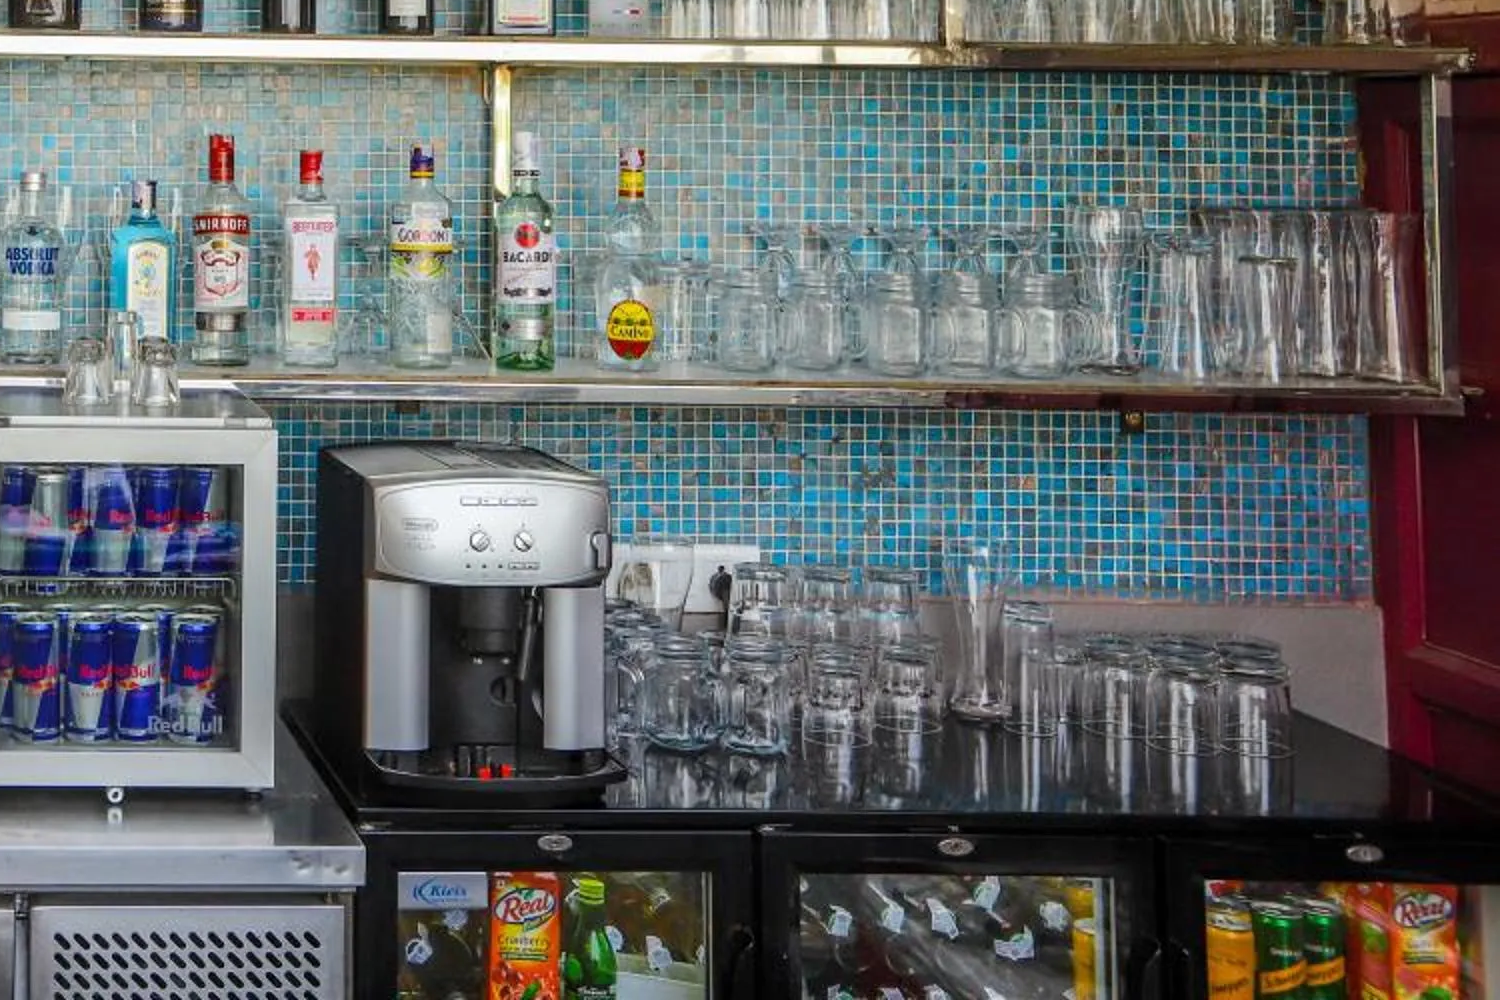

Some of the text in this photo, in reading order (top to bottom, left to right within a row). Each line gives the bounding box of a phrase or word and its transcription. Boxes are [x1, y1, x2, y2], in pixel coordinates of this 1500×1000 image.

[145, 714, 224, 735] Red Bull
[503, 893, 551, 921] Real
